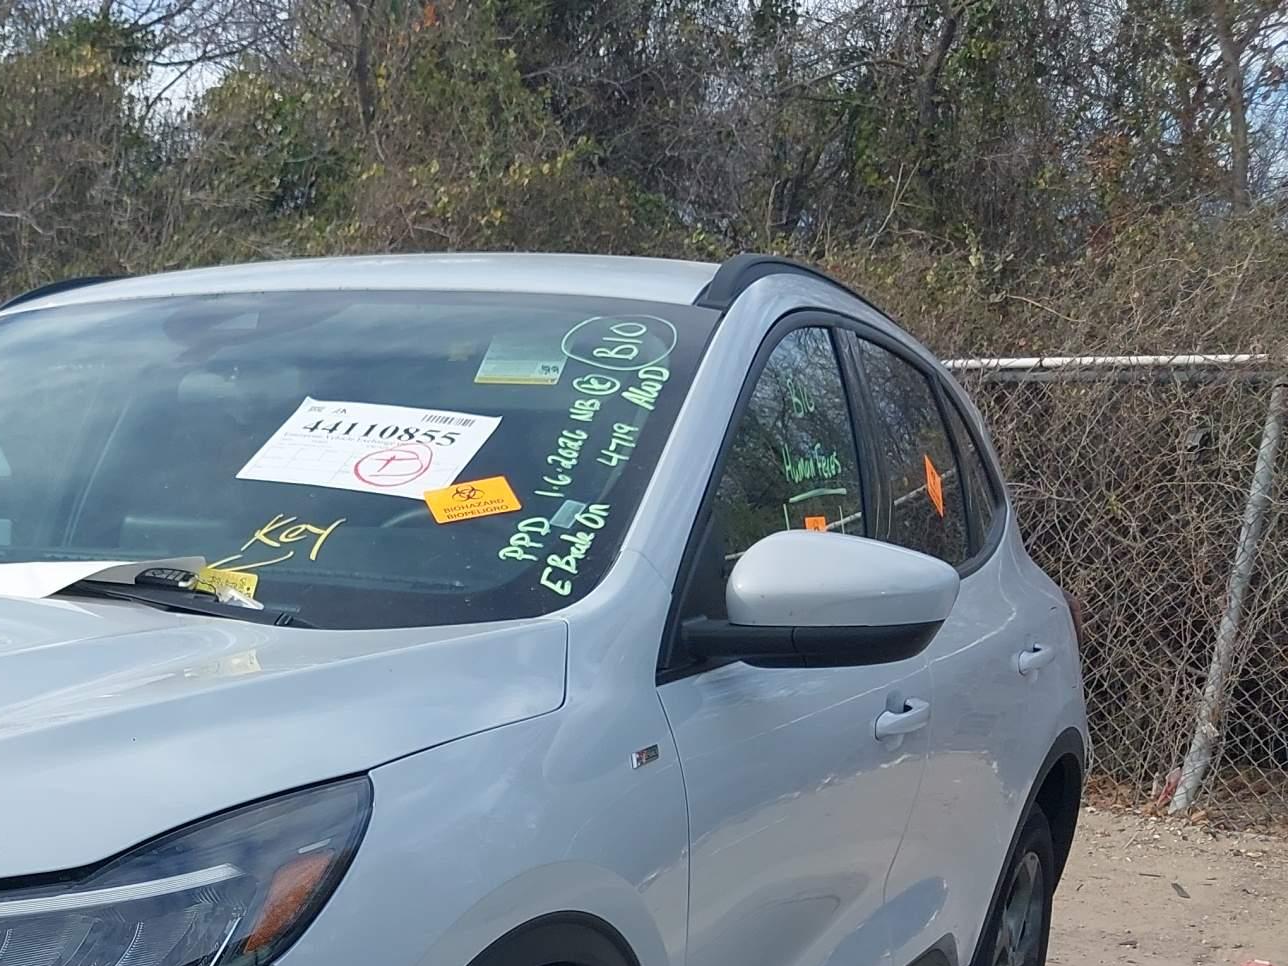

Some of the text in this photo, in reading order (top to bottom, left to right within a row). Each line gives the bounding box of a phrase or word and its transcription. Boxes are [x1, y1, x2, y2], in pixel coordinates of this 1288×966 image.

[592, 322, 648, 361] BIO
[302, 419, 462, 446] 44110855
[443, 498, 505, 514] BIOHAZARD
[446, 504, 510, 520] BIOPELIGRO
[574, 503, 612, 529] On
[498, 517, 551, 561] PPD
